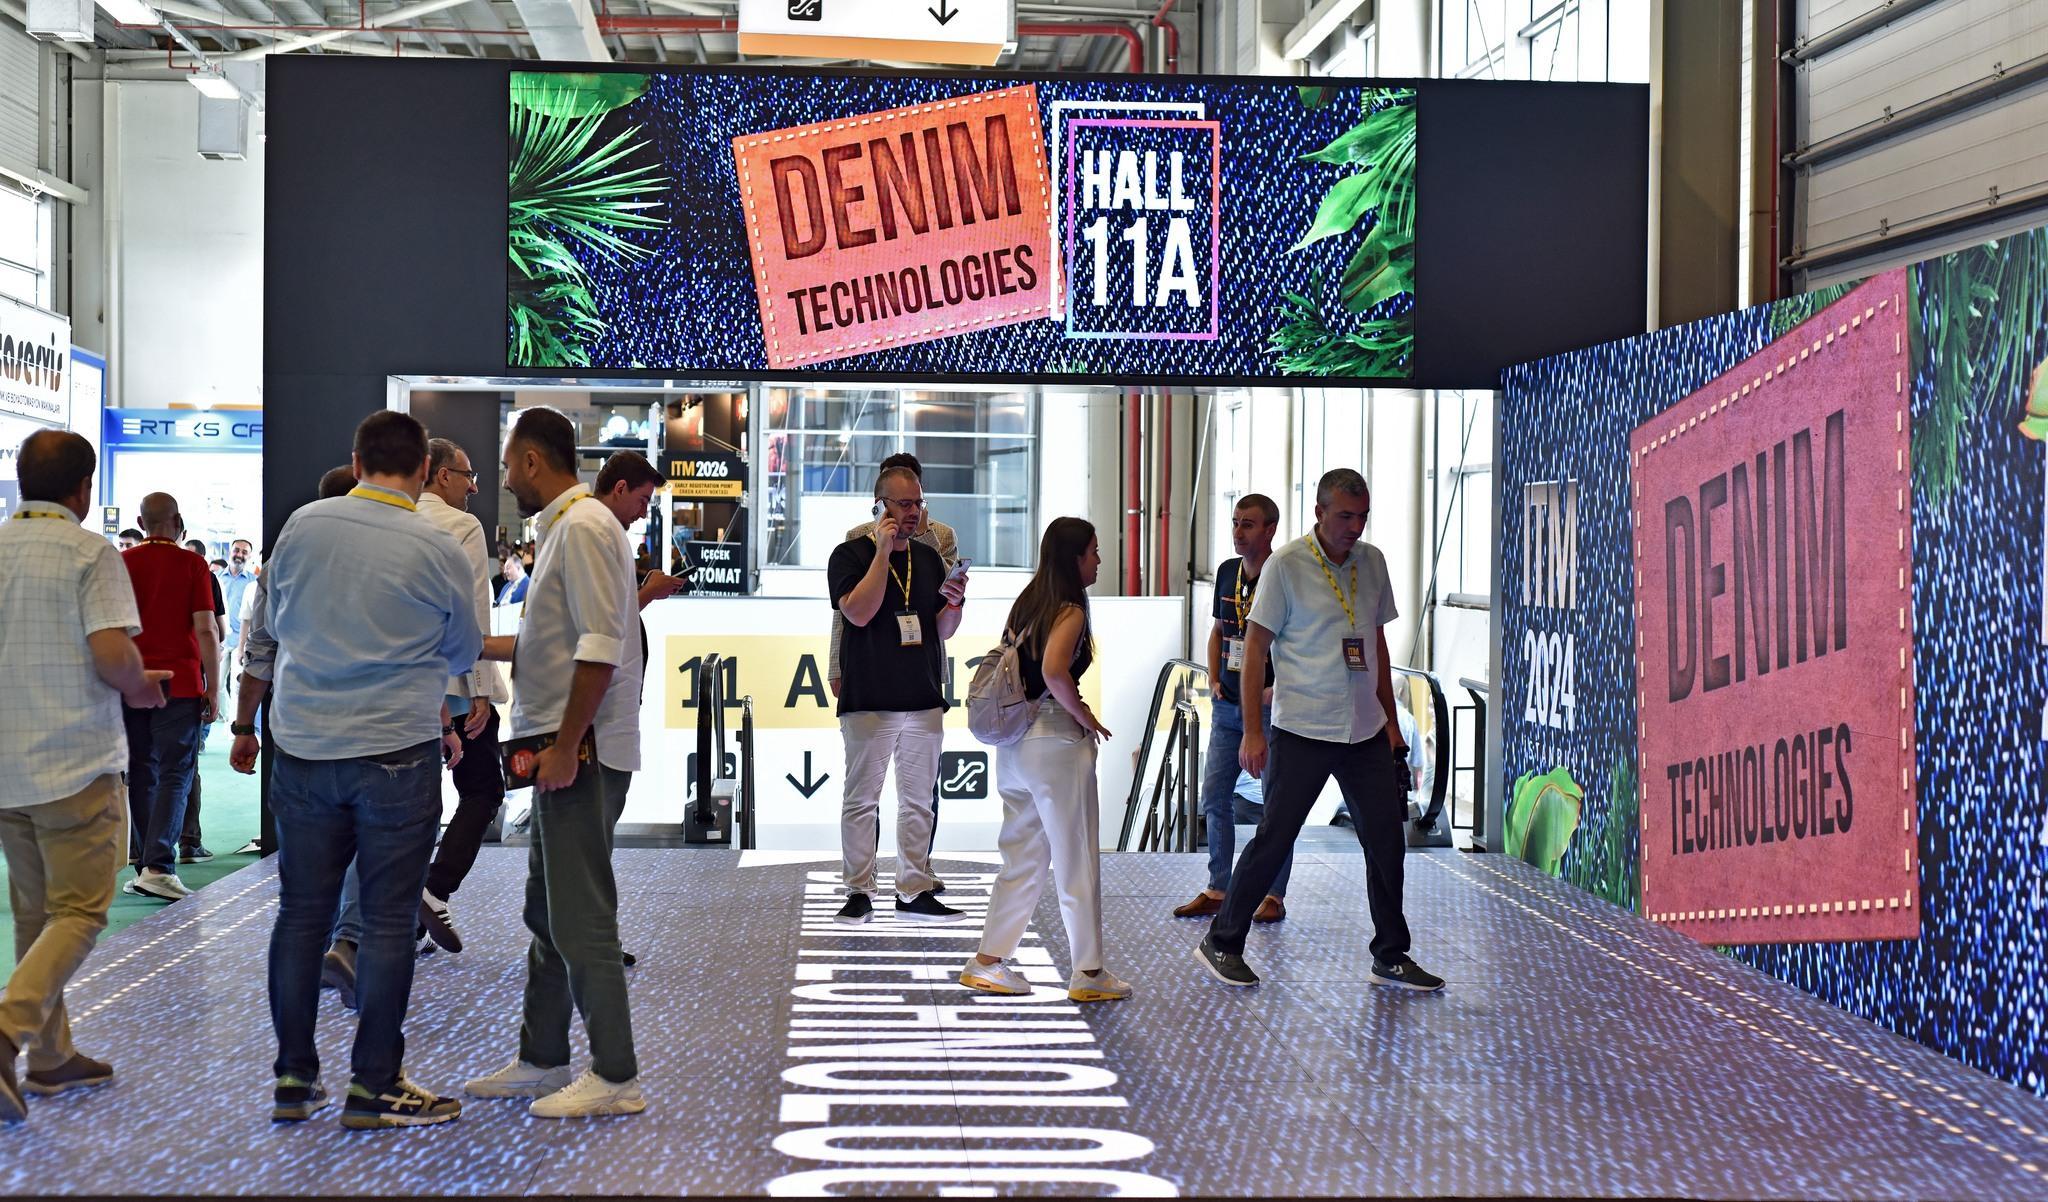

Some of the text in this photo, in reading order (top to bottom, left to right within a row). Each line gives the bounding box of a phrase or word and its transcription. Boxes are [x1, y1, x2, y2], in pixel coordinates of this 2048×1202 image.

[770, 113, 1022, 260] DENIM
[1083, 149, 1195, 210] HALL
[787, 244, 1038, 336] TECHNOLOGIES
[1083, 216, 1200, 307] 11A
[0, 331, 63, 392] aservis
[671, 460, 728, 477] ITM 2026
[701, 547, 730, 562] İÇECEK
[1523, 479, 1577, 610] ITM
[1665, 408, 1848, 703] DENIM
[678, 656, 743, 708] 11
[783, 654, 830, 708] A
[1524, 628, 1576, 732] 2024
[1667, 723, 1853, 855] TECHNOLOGIES
